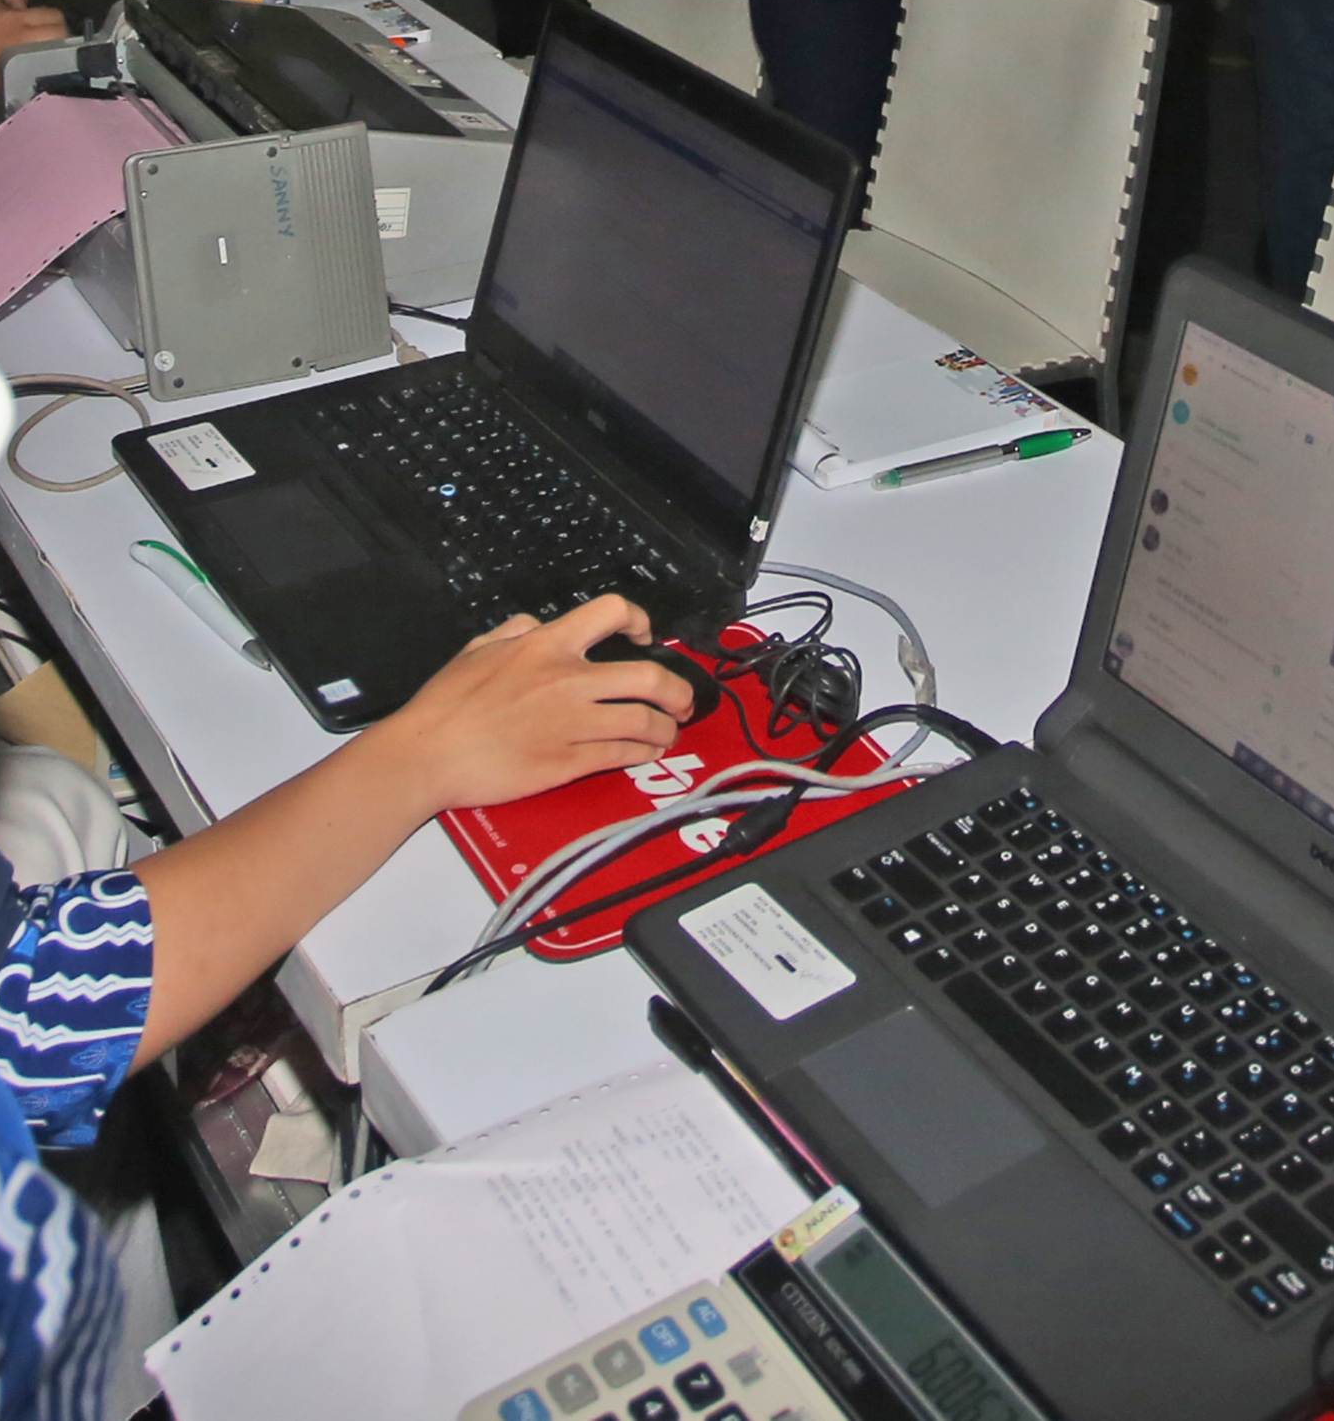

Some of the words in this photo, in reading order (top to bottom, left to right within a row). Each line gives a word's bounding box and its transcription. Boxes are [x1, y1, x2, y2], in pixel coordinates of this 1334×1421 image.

[269, 165, 295, 239] SANNY
[697, 1304, 717, 1324] AC
[779, 1281, 831, 1339] CITIZEN
[650, 1323, 678, 1349] OFF
[689, 1373, 710, 1389] 7
[645, 1401, 663, 1417] 4
